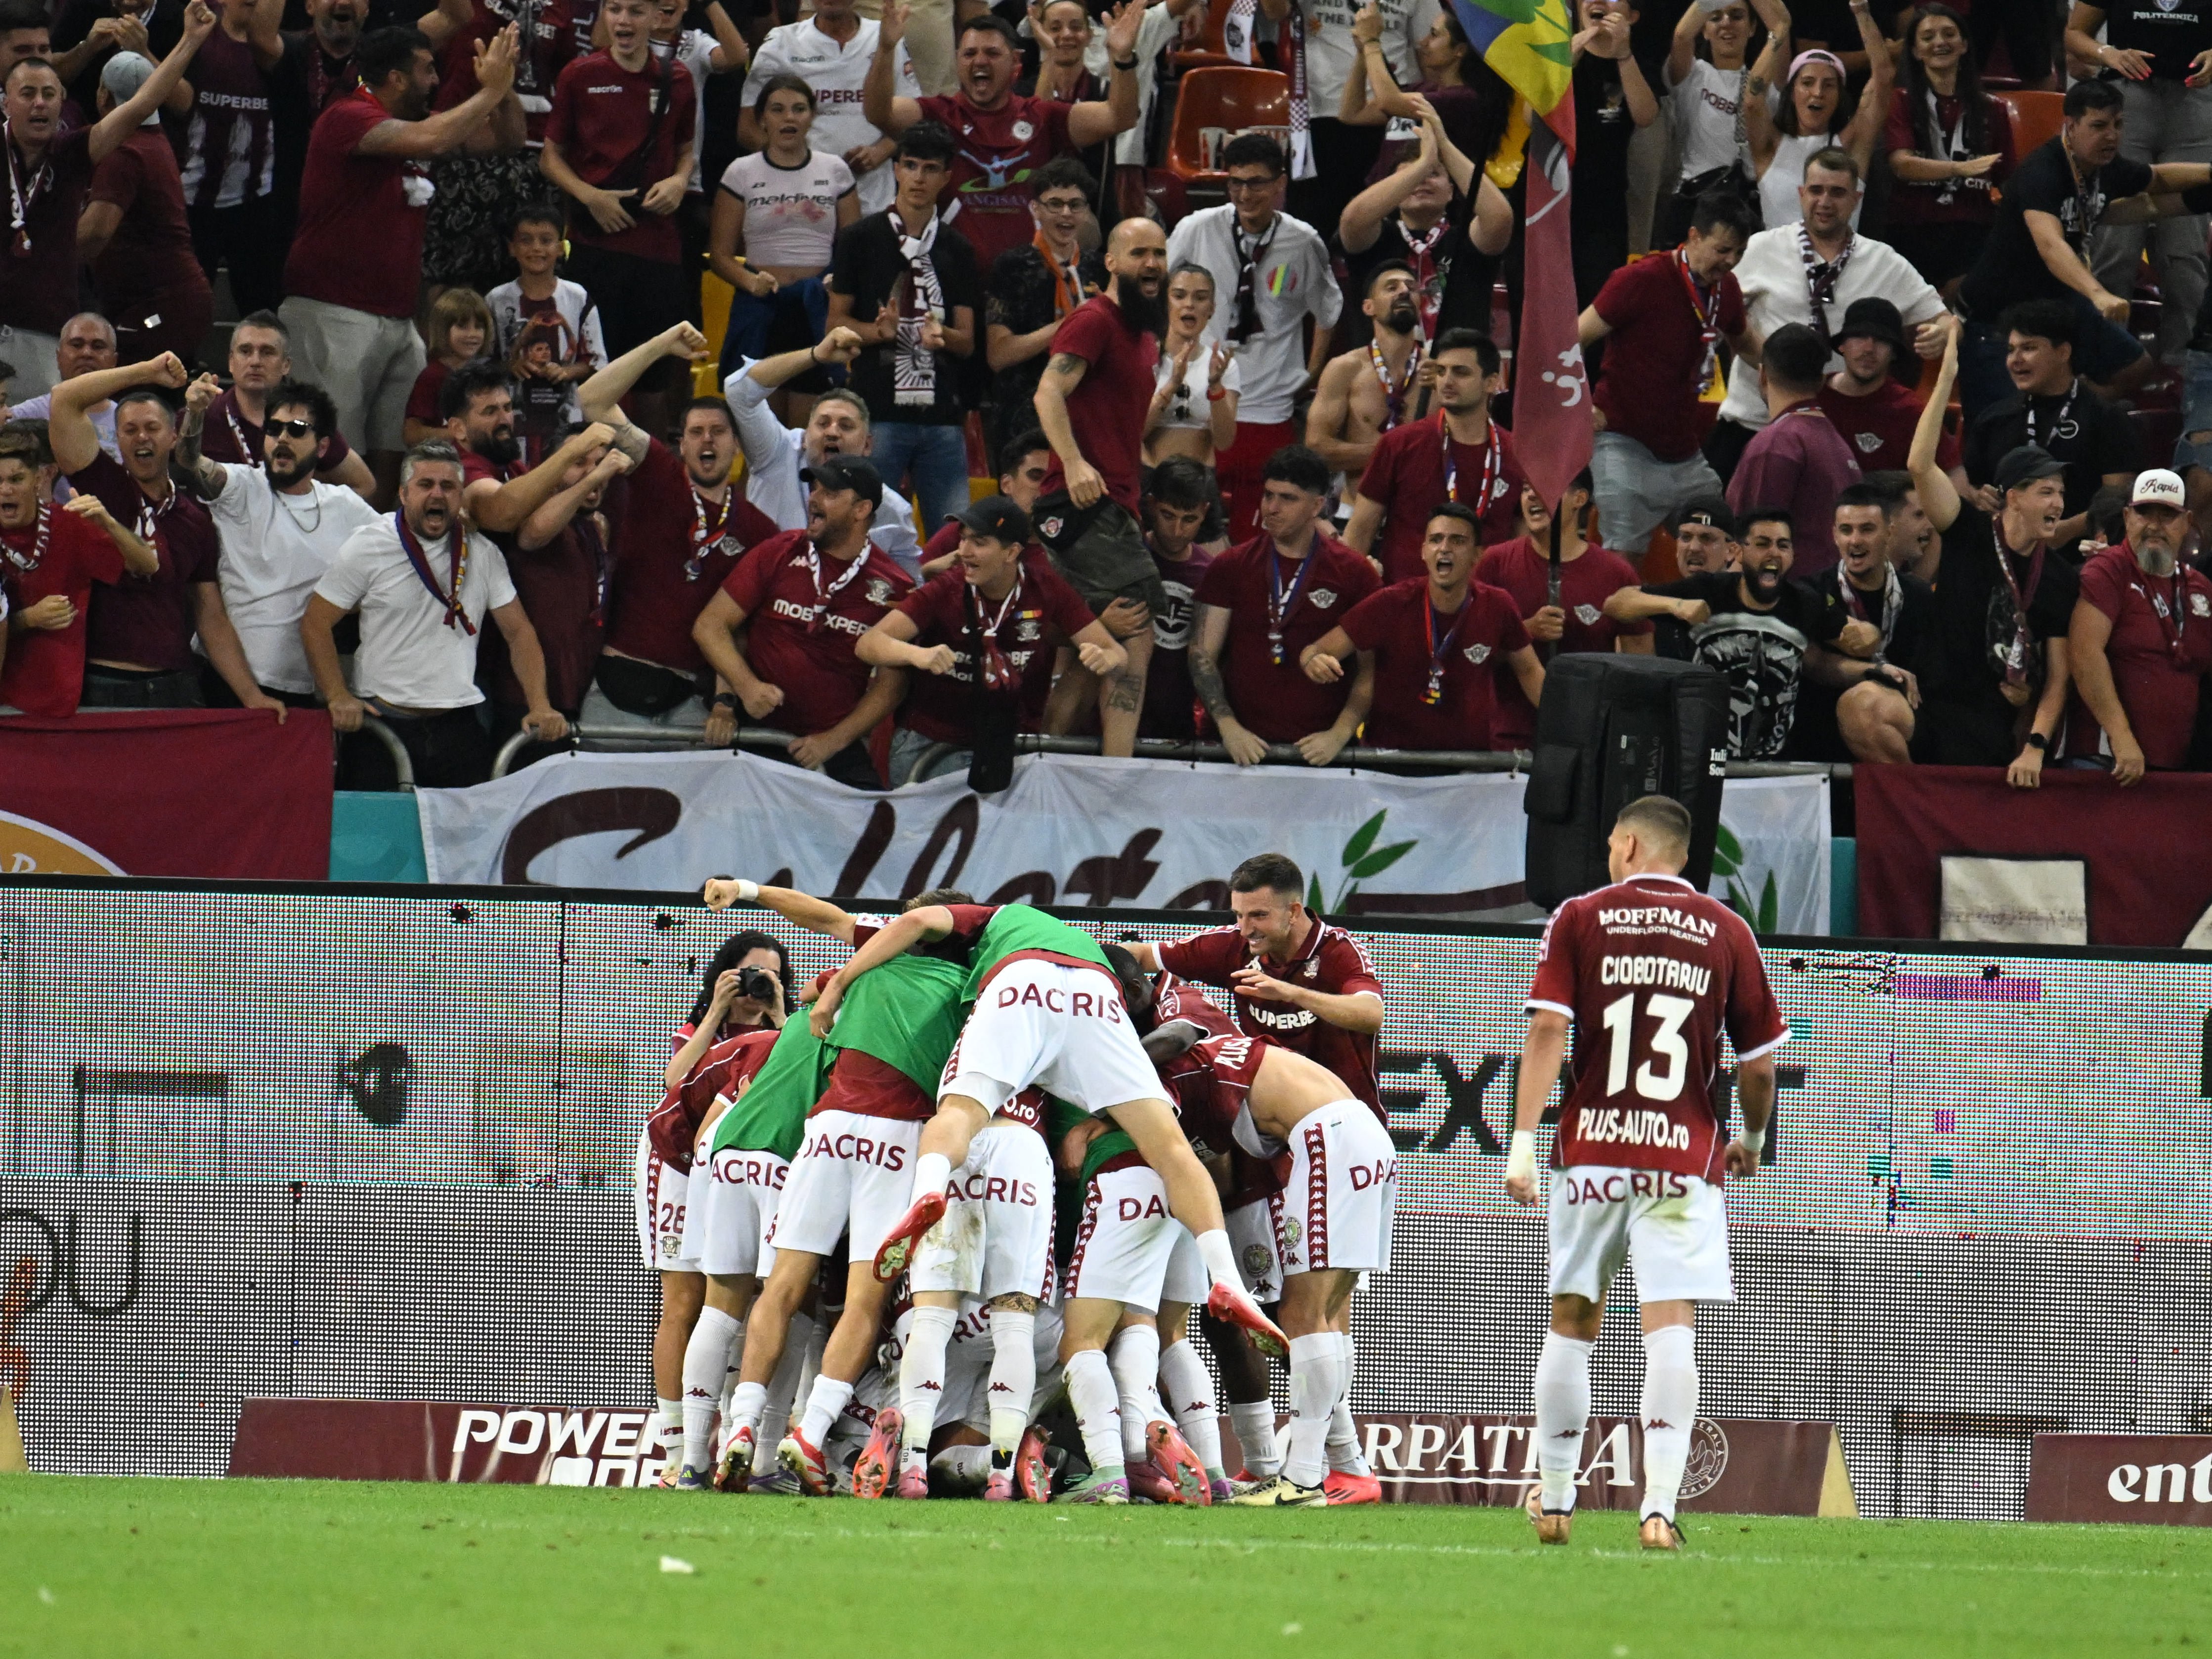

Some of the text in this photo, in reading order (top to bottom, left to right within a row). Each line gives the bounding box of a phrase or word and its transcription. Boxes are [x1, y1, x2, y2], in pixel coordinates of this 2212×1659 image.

[2140, 478, 2179, 494] Rapid
[1599, 906, 1717, 937] HOFFMAN
[1606, 926, 1709, 946] UNDERFLOOR HEATING
[1601, 955, 1712, 996] CIOBOTARIU
[998, 983, 1121, 1024] DACRIS
[1603, 992, 1695, 1102] 13
[1576, 1107, 1690, 1151] PLUS-AUTO.ro
[945, 1174, 1037, 1206] ACRIS
[1567, 1172, 1689, 1205] DACRIS
